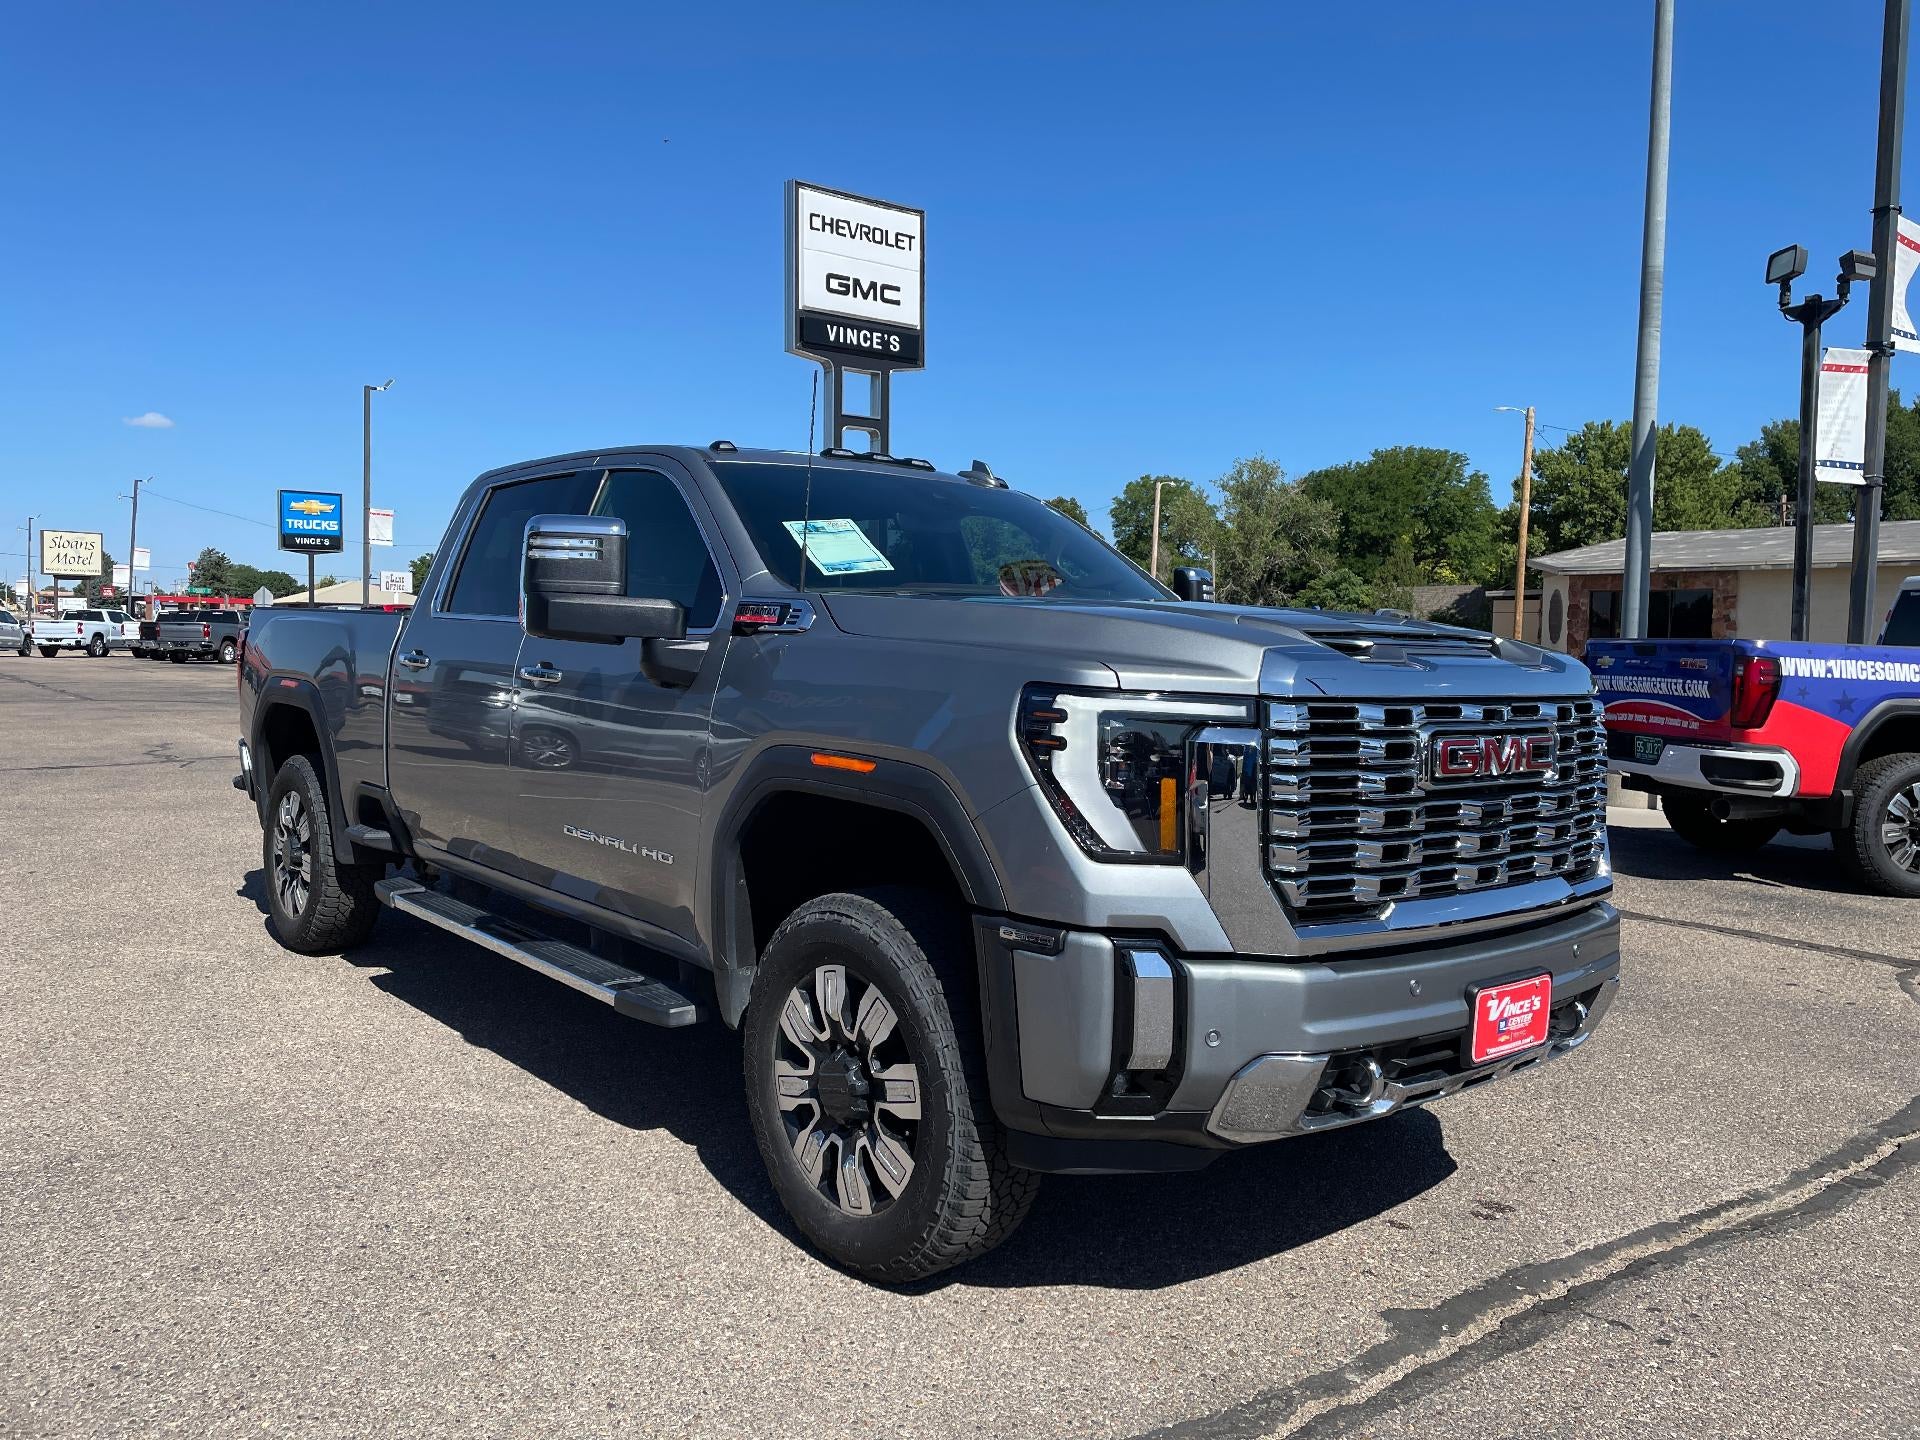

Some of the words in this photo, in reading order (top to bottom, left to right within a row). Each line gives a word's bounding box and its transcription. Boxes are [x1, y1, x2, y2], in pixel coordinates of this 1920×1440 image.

[809, 212, 916, 251] CHEVROLET
[825, 272, 901, 306] GMC
[826, 324, 900, 352] VINCE'S
[285, 518, 339, 531] TRUCKS
[49, 534, 96, 550] Sloans
[294, 537, 330, 546] VINCE'S
[50, 551, 94, 566] Motel
[1438, 735, 1553, 776] GMC
[563, 824, 638, 855] DENALI
[640, 846, 674, 865] HD
[1486, 995, 1542, 1021] VINCE'S
